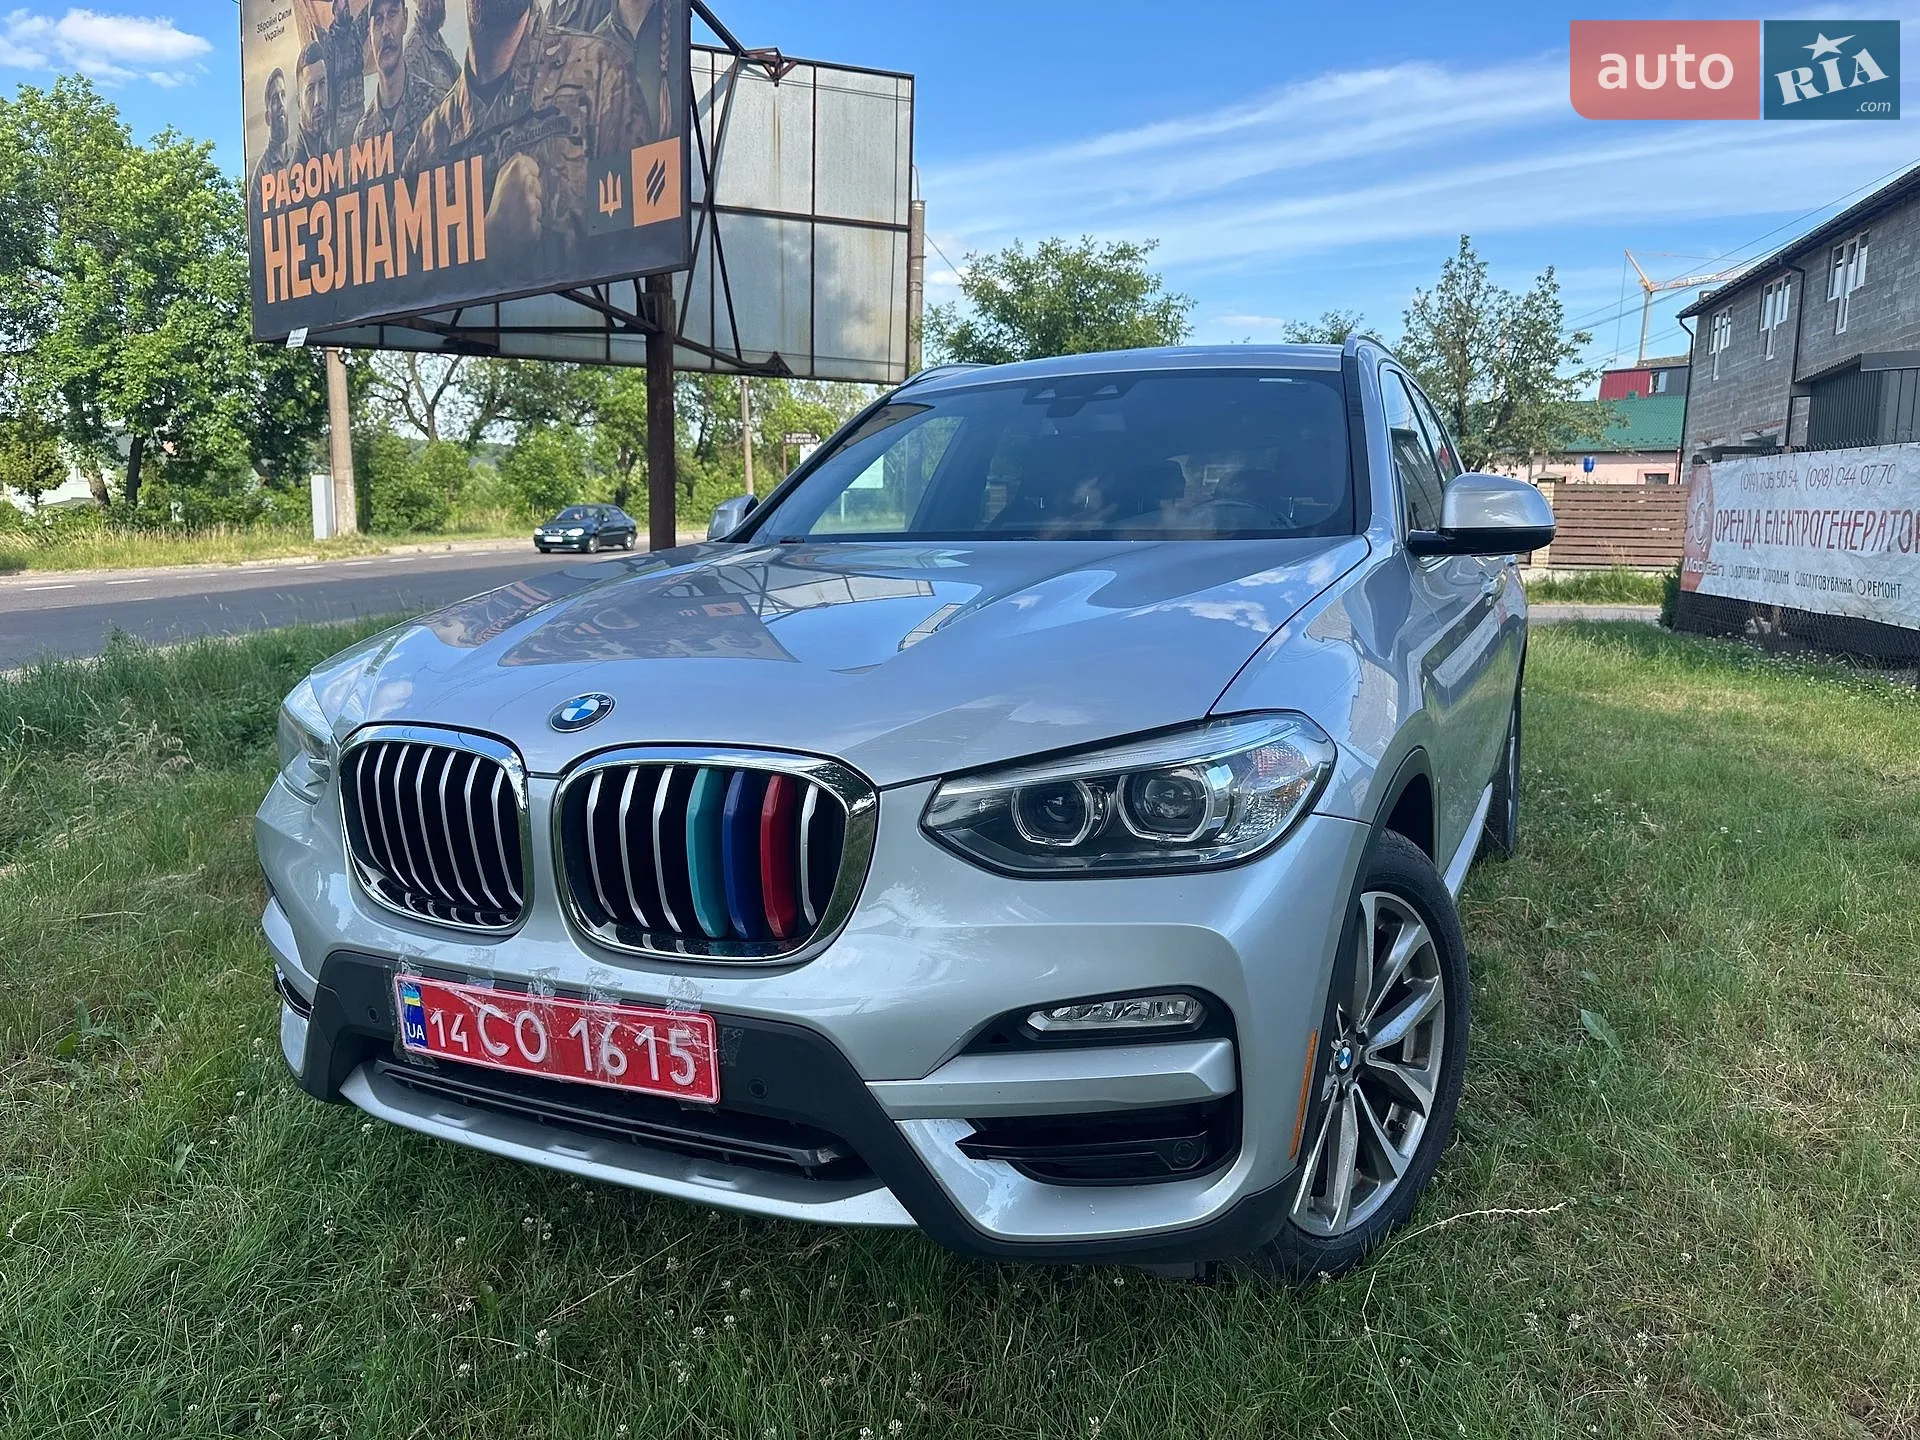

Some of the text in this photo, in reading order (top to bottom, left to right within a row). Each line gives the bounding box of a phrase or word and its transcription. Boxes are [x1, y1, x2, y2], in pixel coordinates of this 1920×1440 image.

[261, 131, 394, 212] РАЗОМ МИ
[263, 155, 487, 304] НЕЗЛАМНІ
[1805, 464, 1834, 491] (098)
[1715, 509, 1761, 549] ОРЕНДА
[1868, 580, 1902, 600] РЕМОНТ
[406, 1021, 426, 1042] UA
[568, 1017, 697, 1087] 1615
